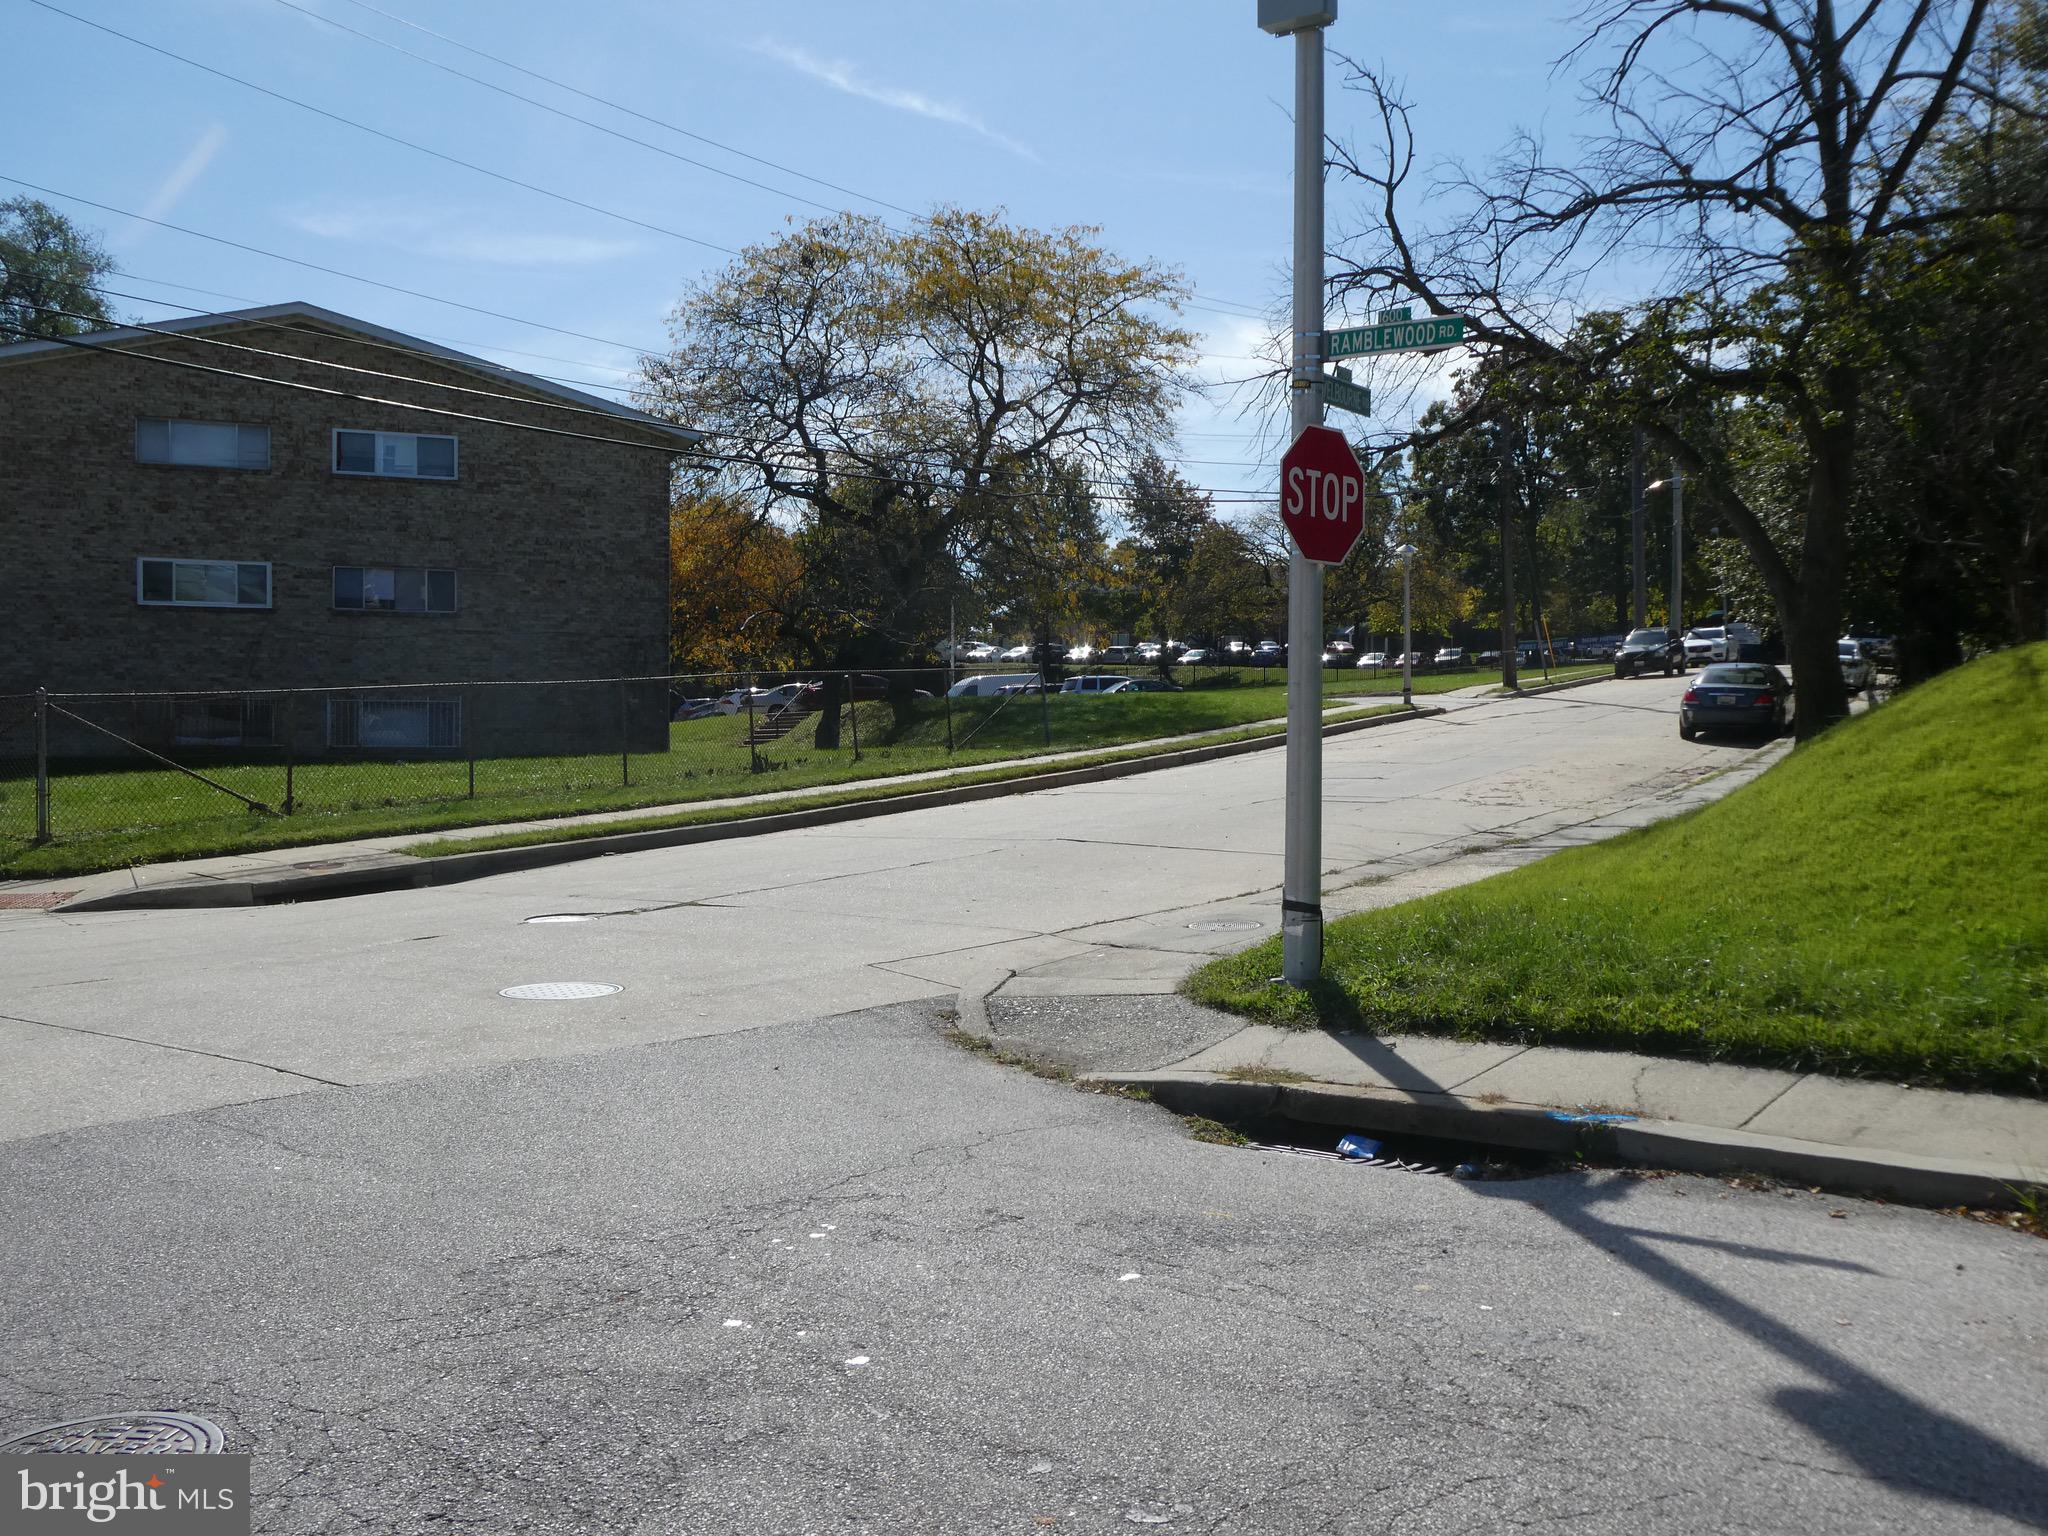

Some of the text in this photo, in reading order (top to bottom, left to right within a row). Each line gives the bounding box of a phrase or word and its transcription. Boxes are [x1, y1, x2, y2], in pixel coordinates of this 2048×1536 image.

[1379, 310, 1403, 323] 1600
[1331, 323, 1436, 355] RAMBLEWOOD
[1287, 466, 1359, 523] STOP
